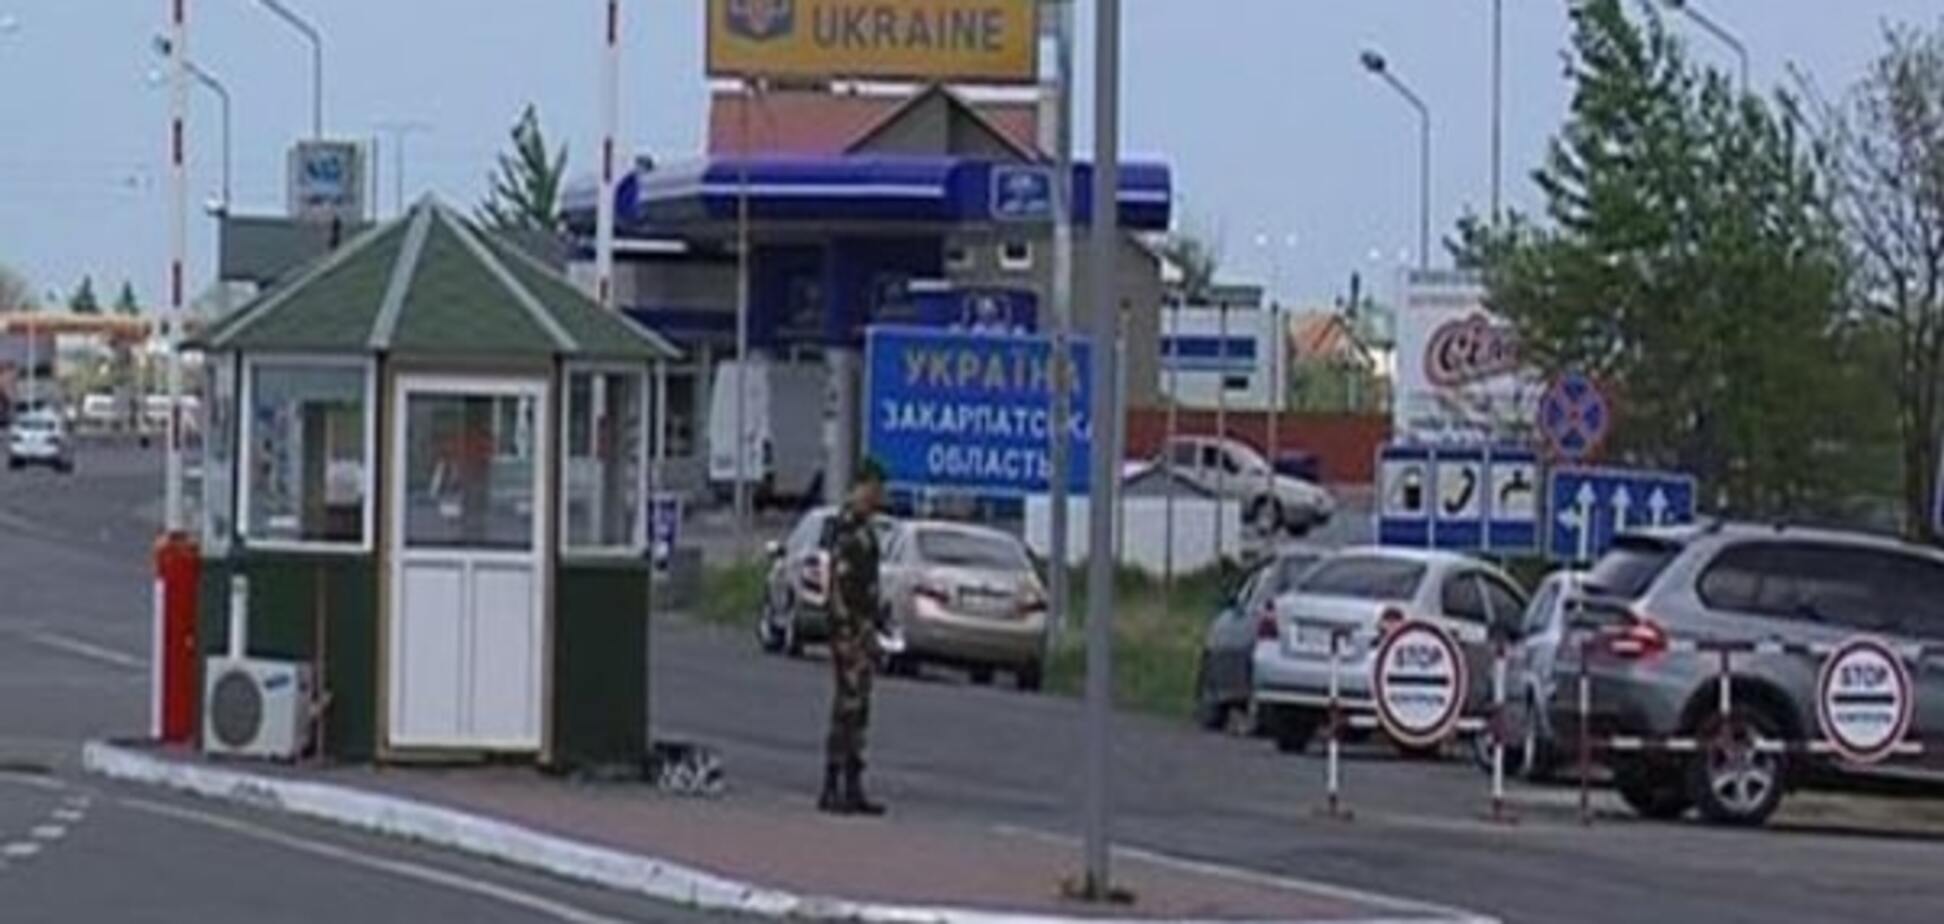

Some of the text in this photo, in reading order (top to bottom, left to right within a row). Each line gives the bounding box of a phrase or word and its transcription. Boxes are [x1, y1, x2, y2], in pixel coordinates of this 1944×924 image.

[813, 5, 1004, 49] UKRAINE
[927, 444, 1054, 479] ОБЛАСТЬ
[1393, 645, 1443, 668] STOP
[1840, 663, 1888, 687] STOP
